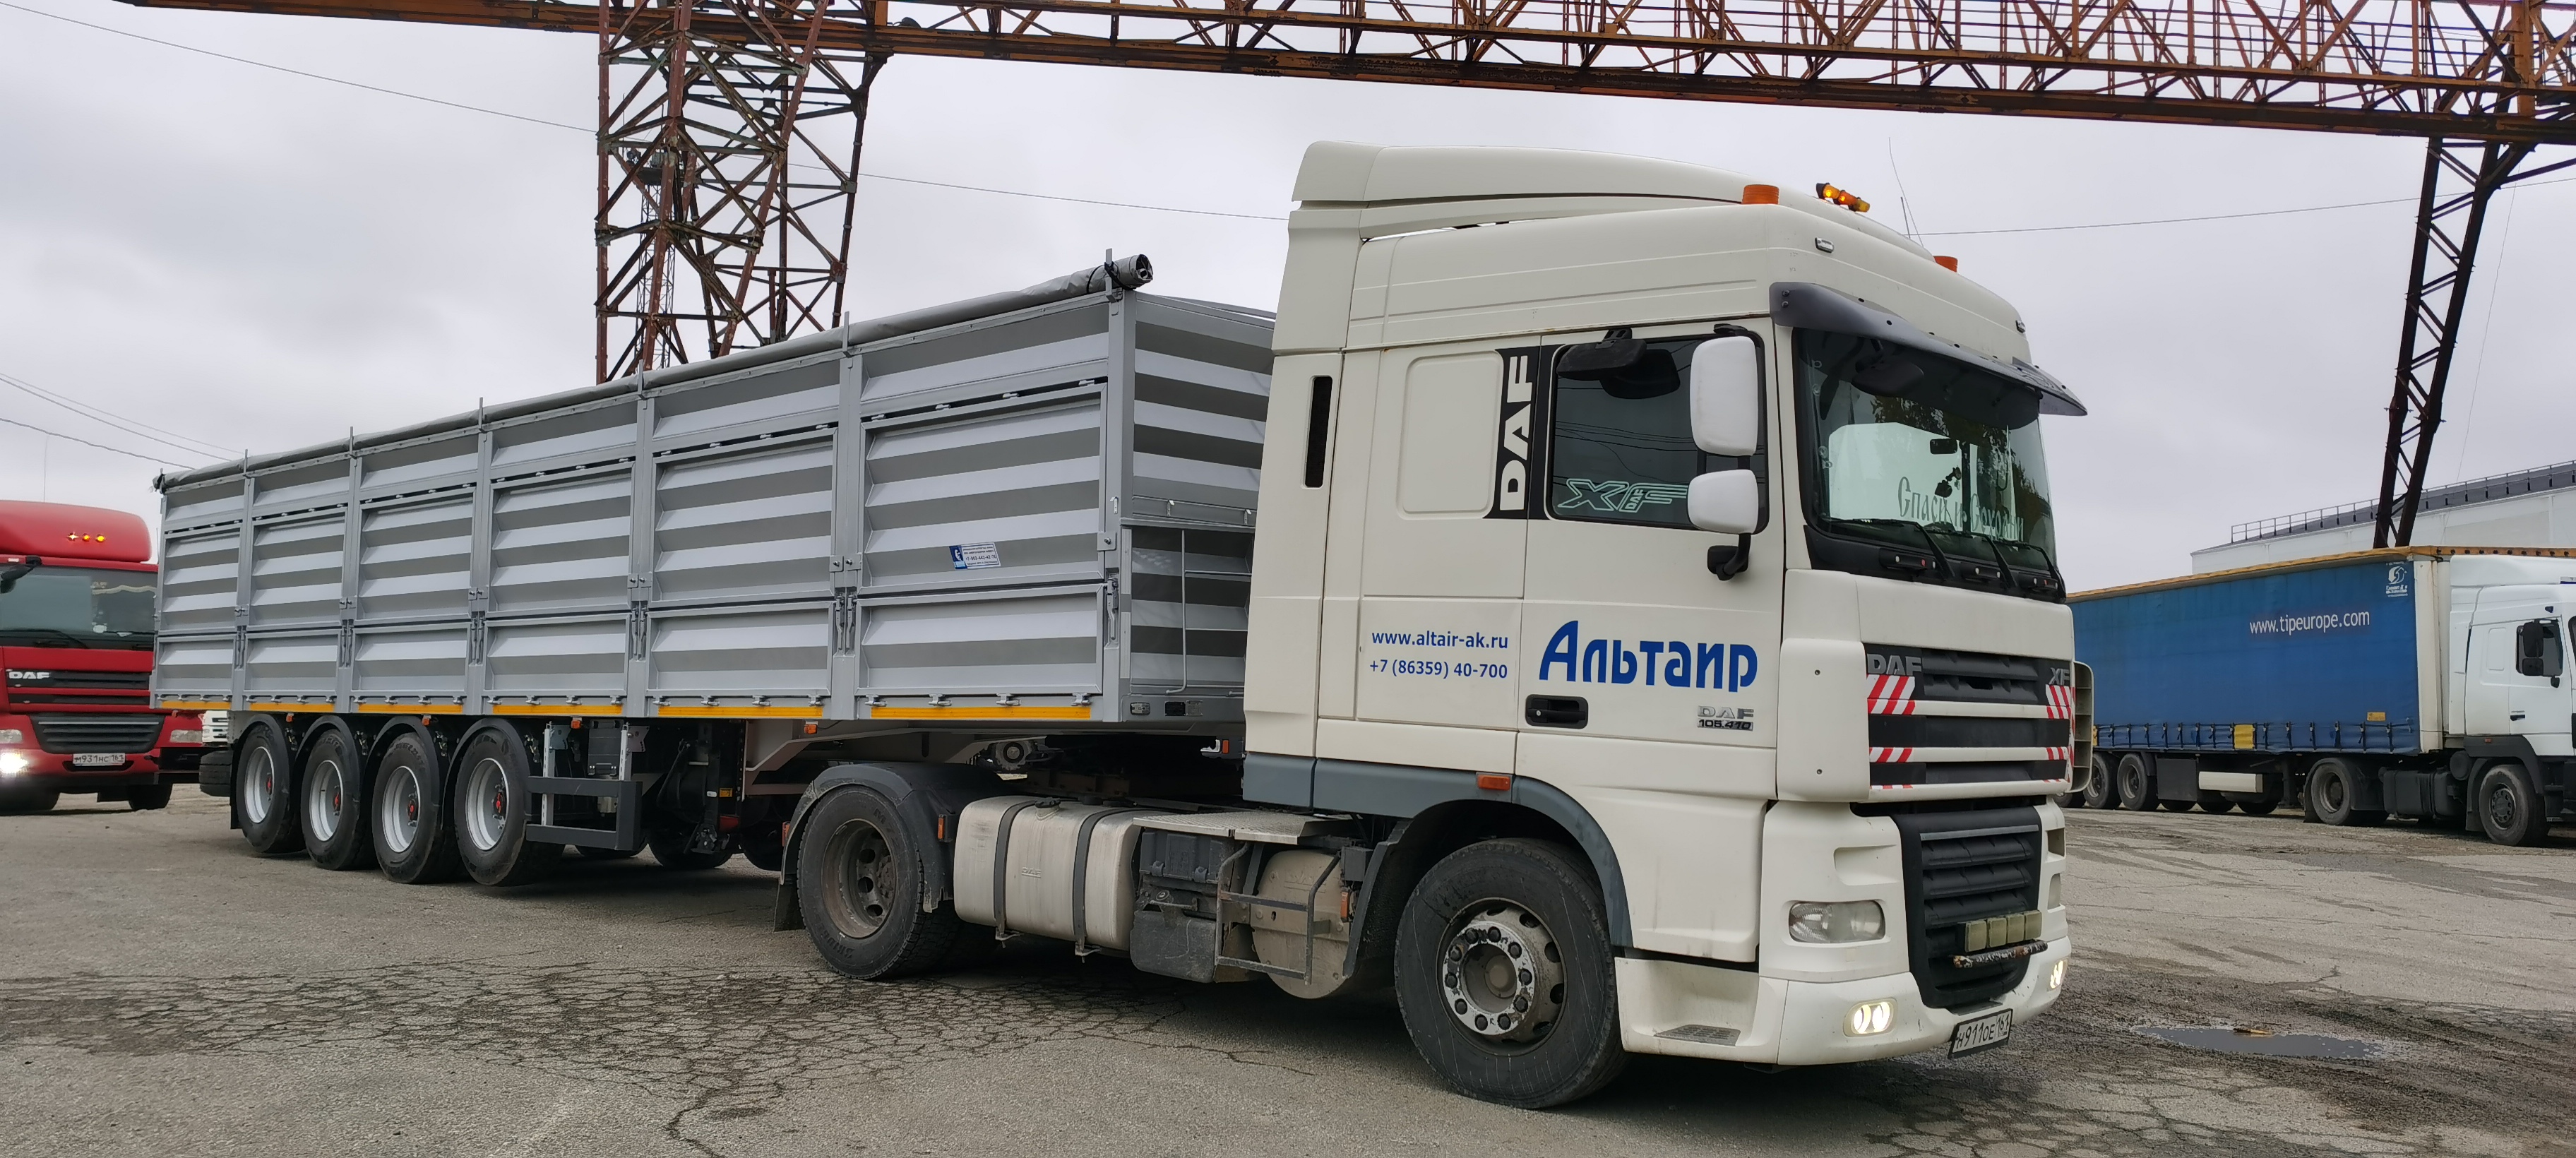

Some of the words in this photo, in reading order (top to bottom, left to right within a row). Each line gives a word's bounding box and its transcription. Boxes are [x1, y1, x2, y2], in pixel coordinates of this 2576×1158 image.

[1499, 355, 1532, 511] DAF
[1558, 478, 1689, 513] XF
[1625, 489, 1645, 510] DAF
[1898, 477, 1948, 525] Спаси
[2249, 611, 2371, 636] www.tipeurope.com
[1371, 630, 1508, 649] www.altair-ak.ru
[1539, 620, 1758, 693] Альтаир
[1866, 653, 1922, 676] DAF
[8, 671, 50, 679] DAF
[1369, 659, 1388, 673] +7
[1392, 659, 1449, 679] (86359)
[1453, 662, 1508, 679] 40-700
[2049, 667, 2070, 686] XF
[1697, 705, 1754, 719] DAF
[1698, 719, 1752, 730] 105.410
[1996, 1013, 2010, 1038] 161
